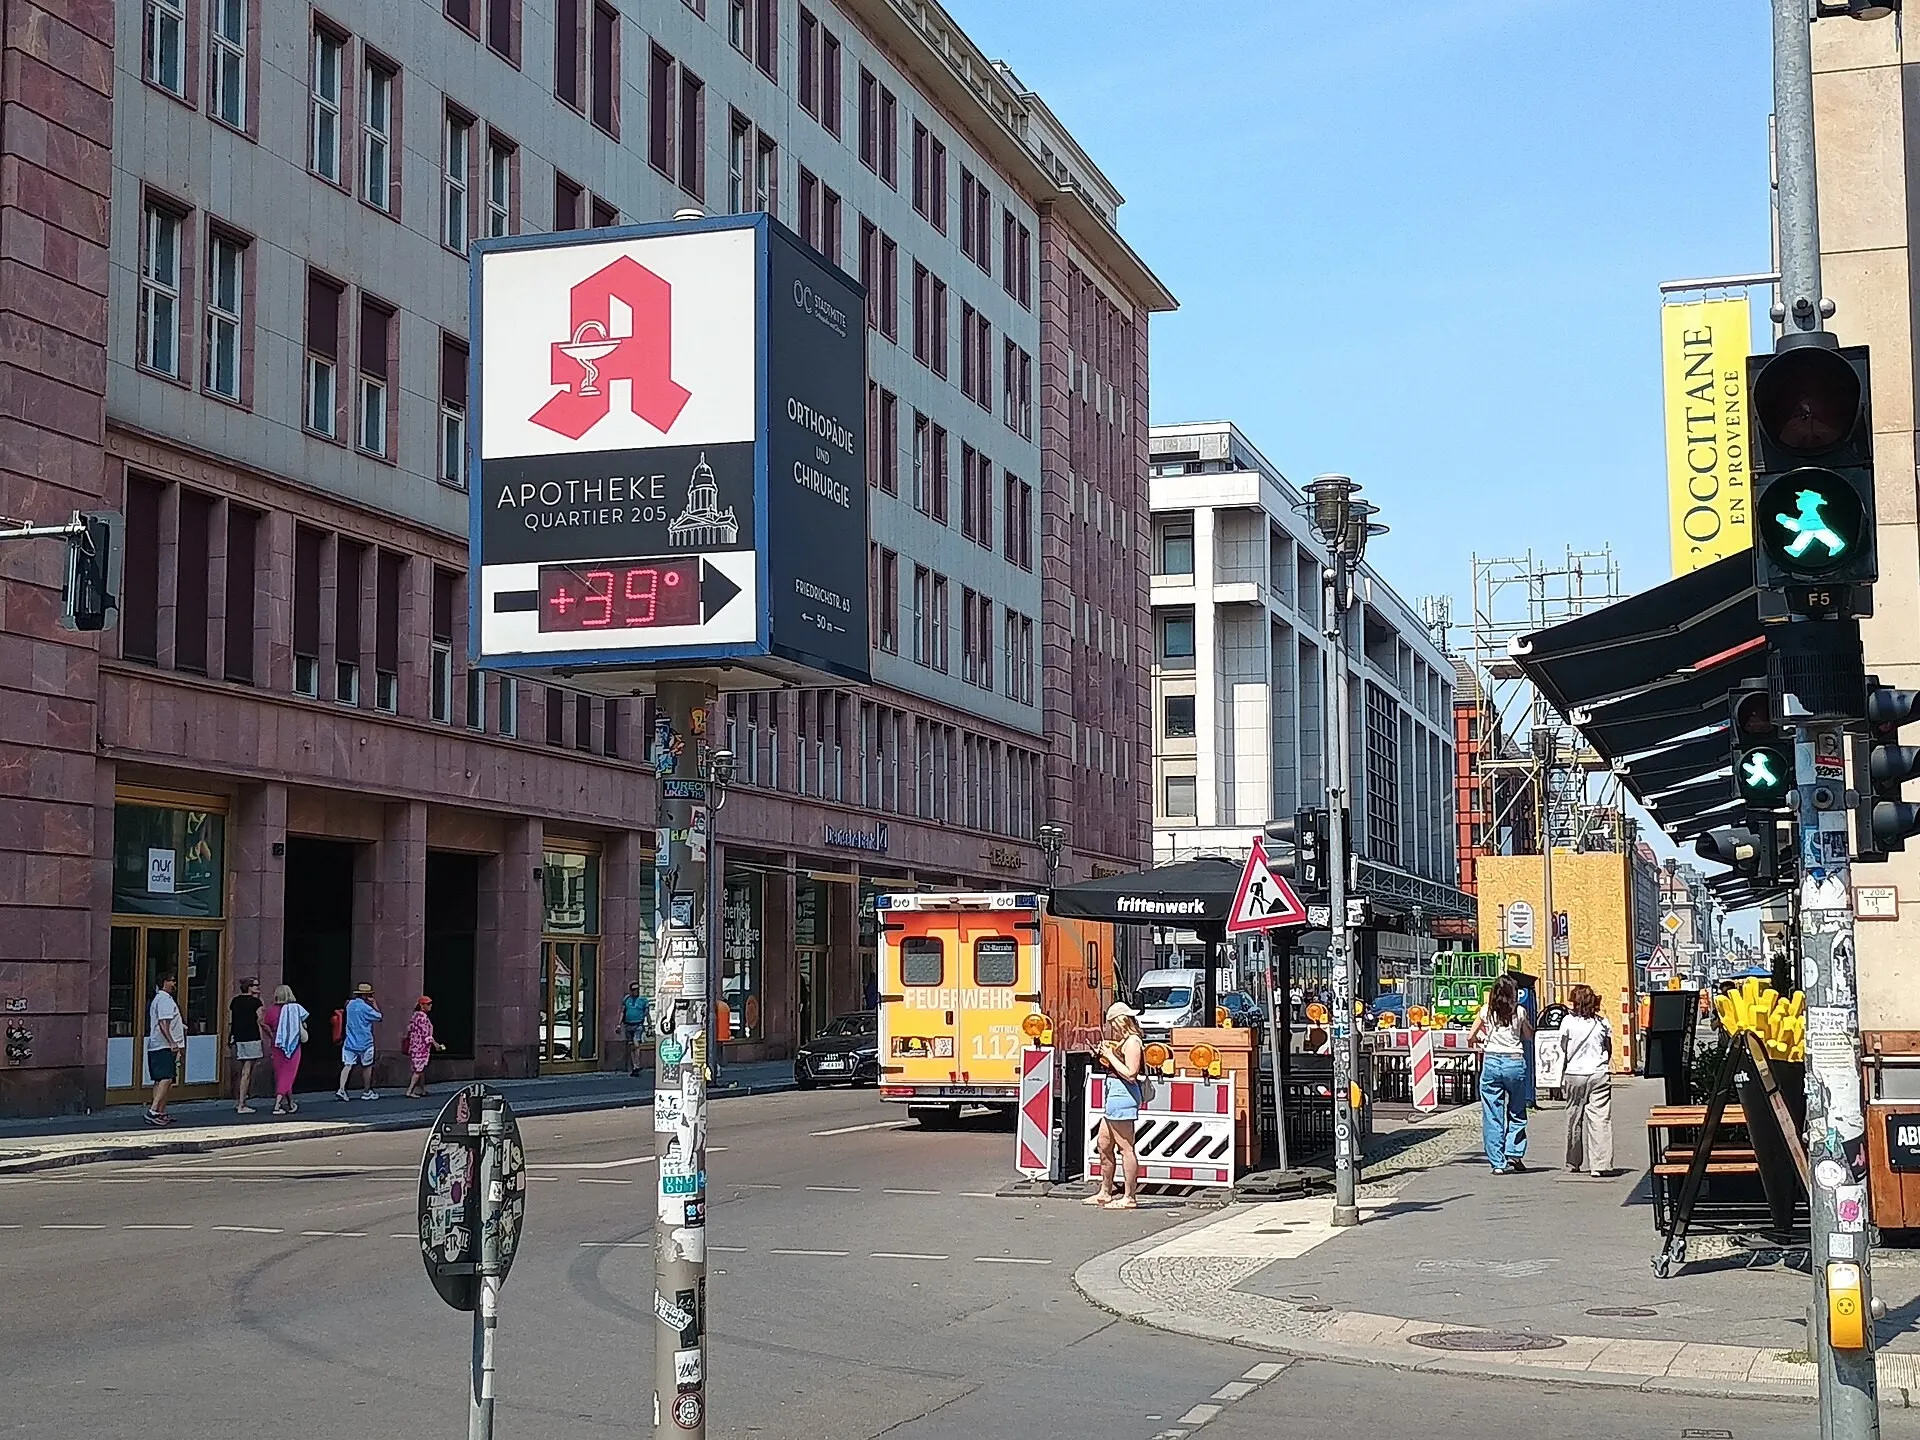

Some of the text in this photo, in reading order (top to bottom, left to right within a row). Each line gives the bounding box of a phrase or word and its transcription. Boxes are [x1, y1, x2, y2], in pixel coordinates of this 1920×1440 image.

[787, 397, 855, 455] ORTHOPÄDIE
[815, 445, 830, 465] UND
[1683, 325, 1722, 570] 'OCCITANE
[1725, 370, 1745, 525] EN PROVENCE
[497, 474, 667, 509] APOTHEKE
[793, 461, 850, 509] CHIRURGIE
[524, 506, 667, 532] QUARTIER 205
[1808, 592, 1830, 606] F5
[816, 614, 826, 630] 50
[151, 858, 172, 873] nur
[151, 873, 172, 883] coffee
[1116, 896, 1205, 915] frittenwerk
[904, 988, 1016, 1010] FEUERWEHR
[988, 1025, 1020, 1034] NOTRUF
[971, 1035, 1020, 1060] 112
